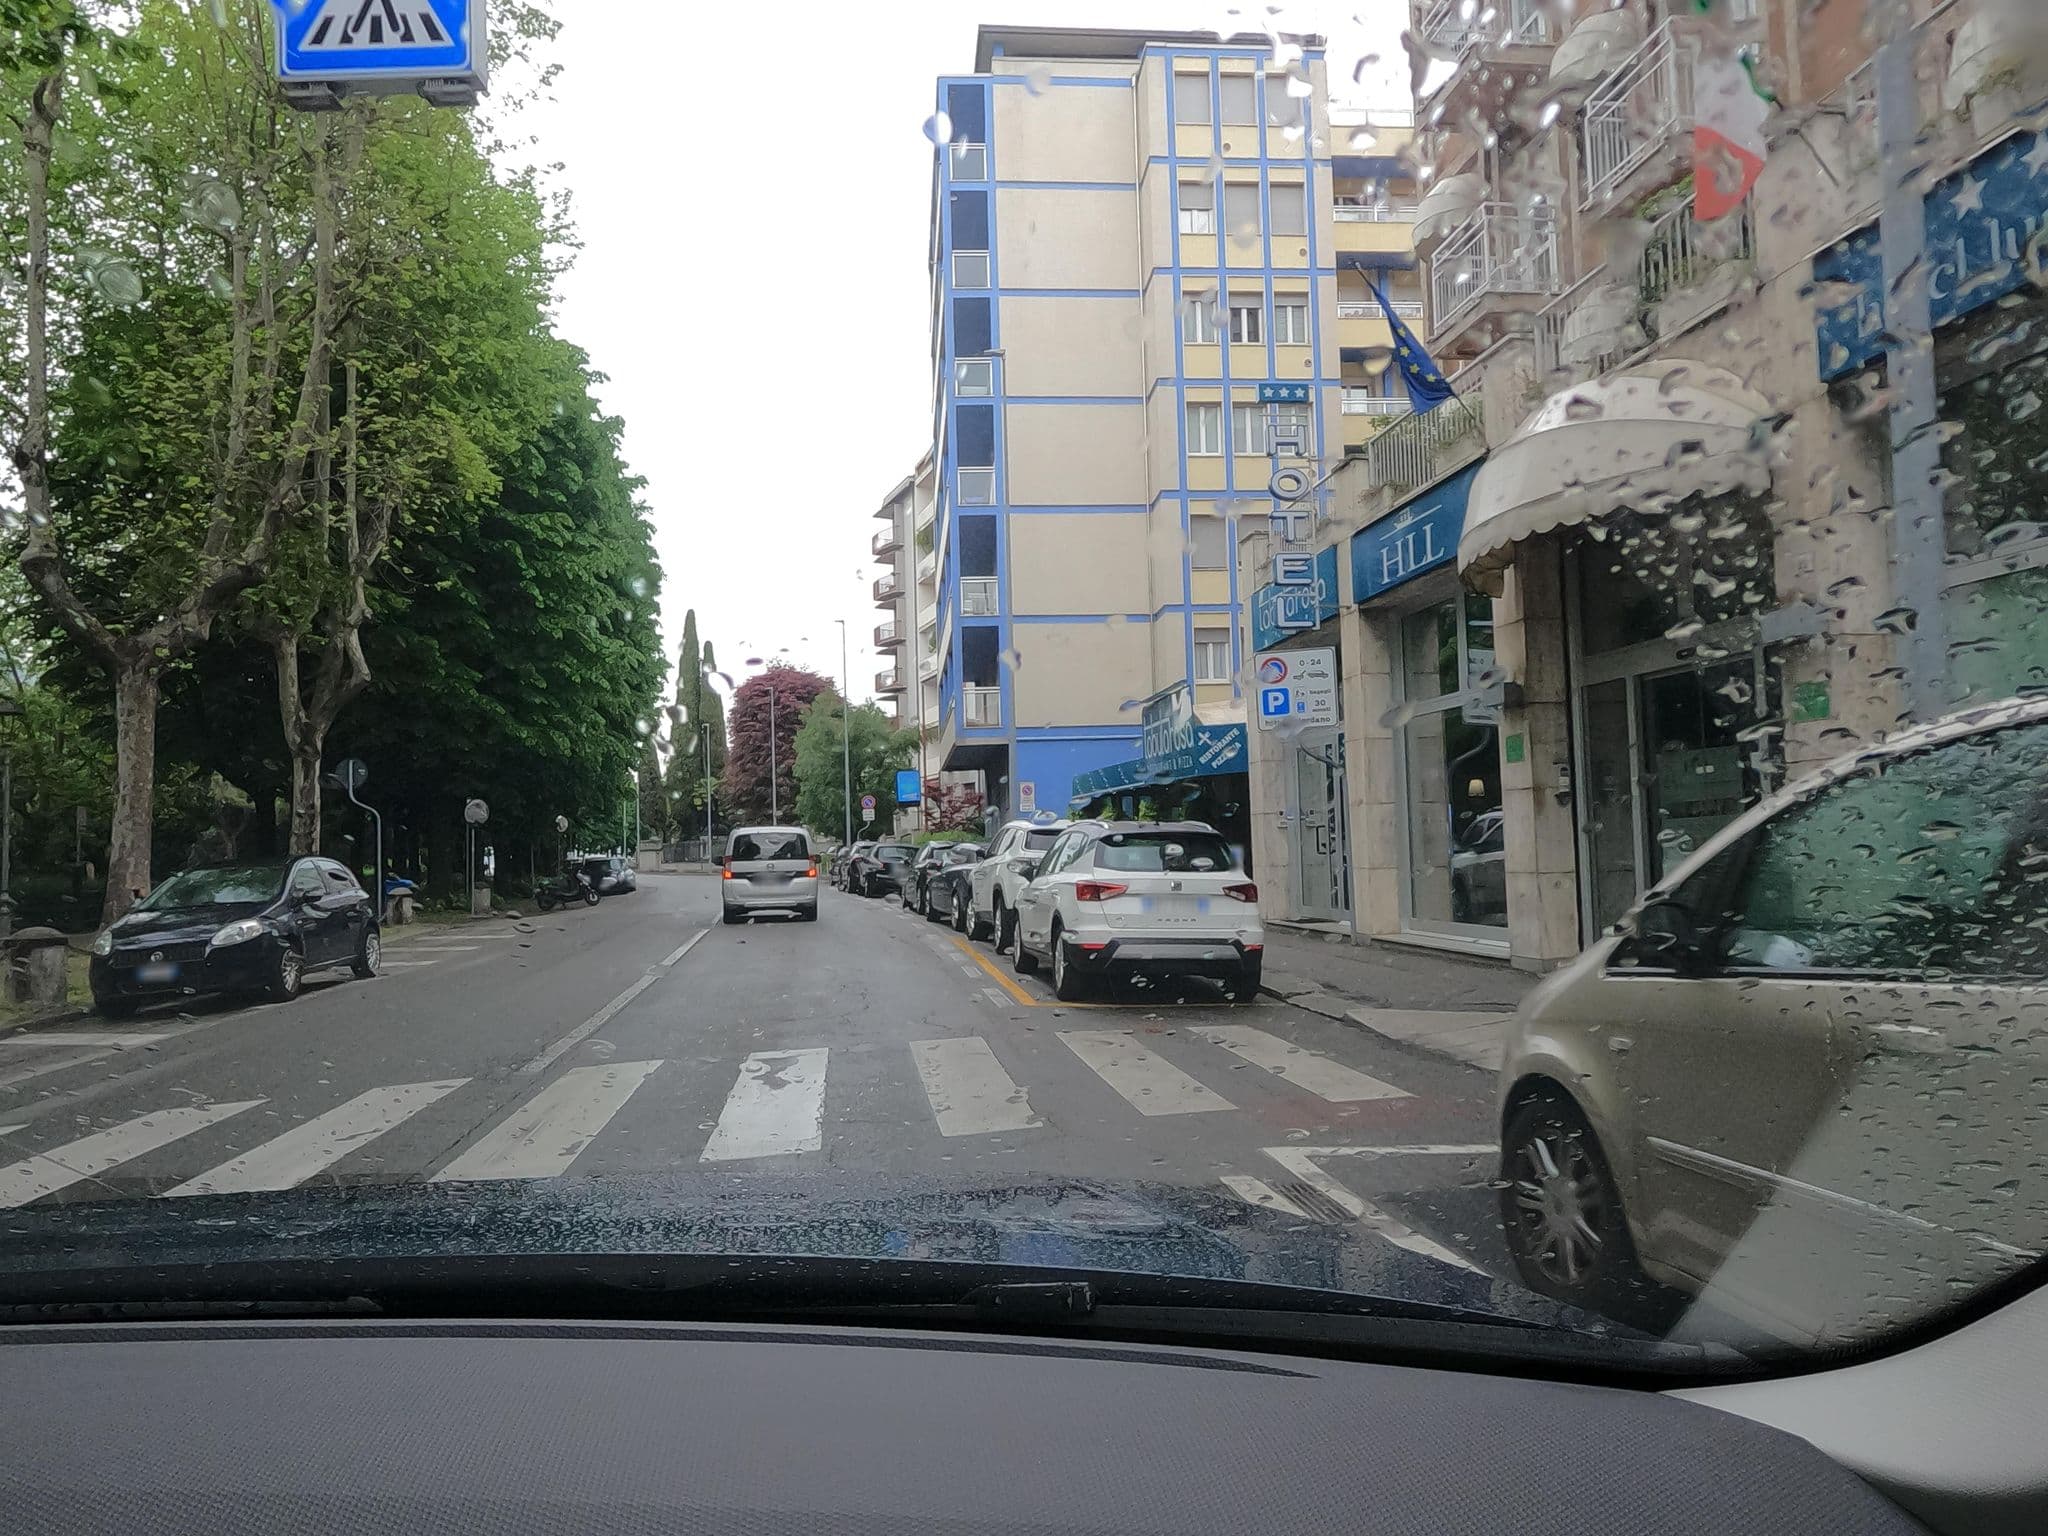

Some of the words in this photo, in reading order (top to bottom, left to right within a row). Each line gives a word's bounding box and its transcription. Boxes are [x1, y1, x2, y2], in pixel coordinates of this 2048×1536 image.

[1266, 424, 1316, 629] HOTEL
[1268, 692, 1285, 713] P
[1199, 728, 1240, 764] RISTORANTE
[1211, 742, 1241, 769] PIZZIA
